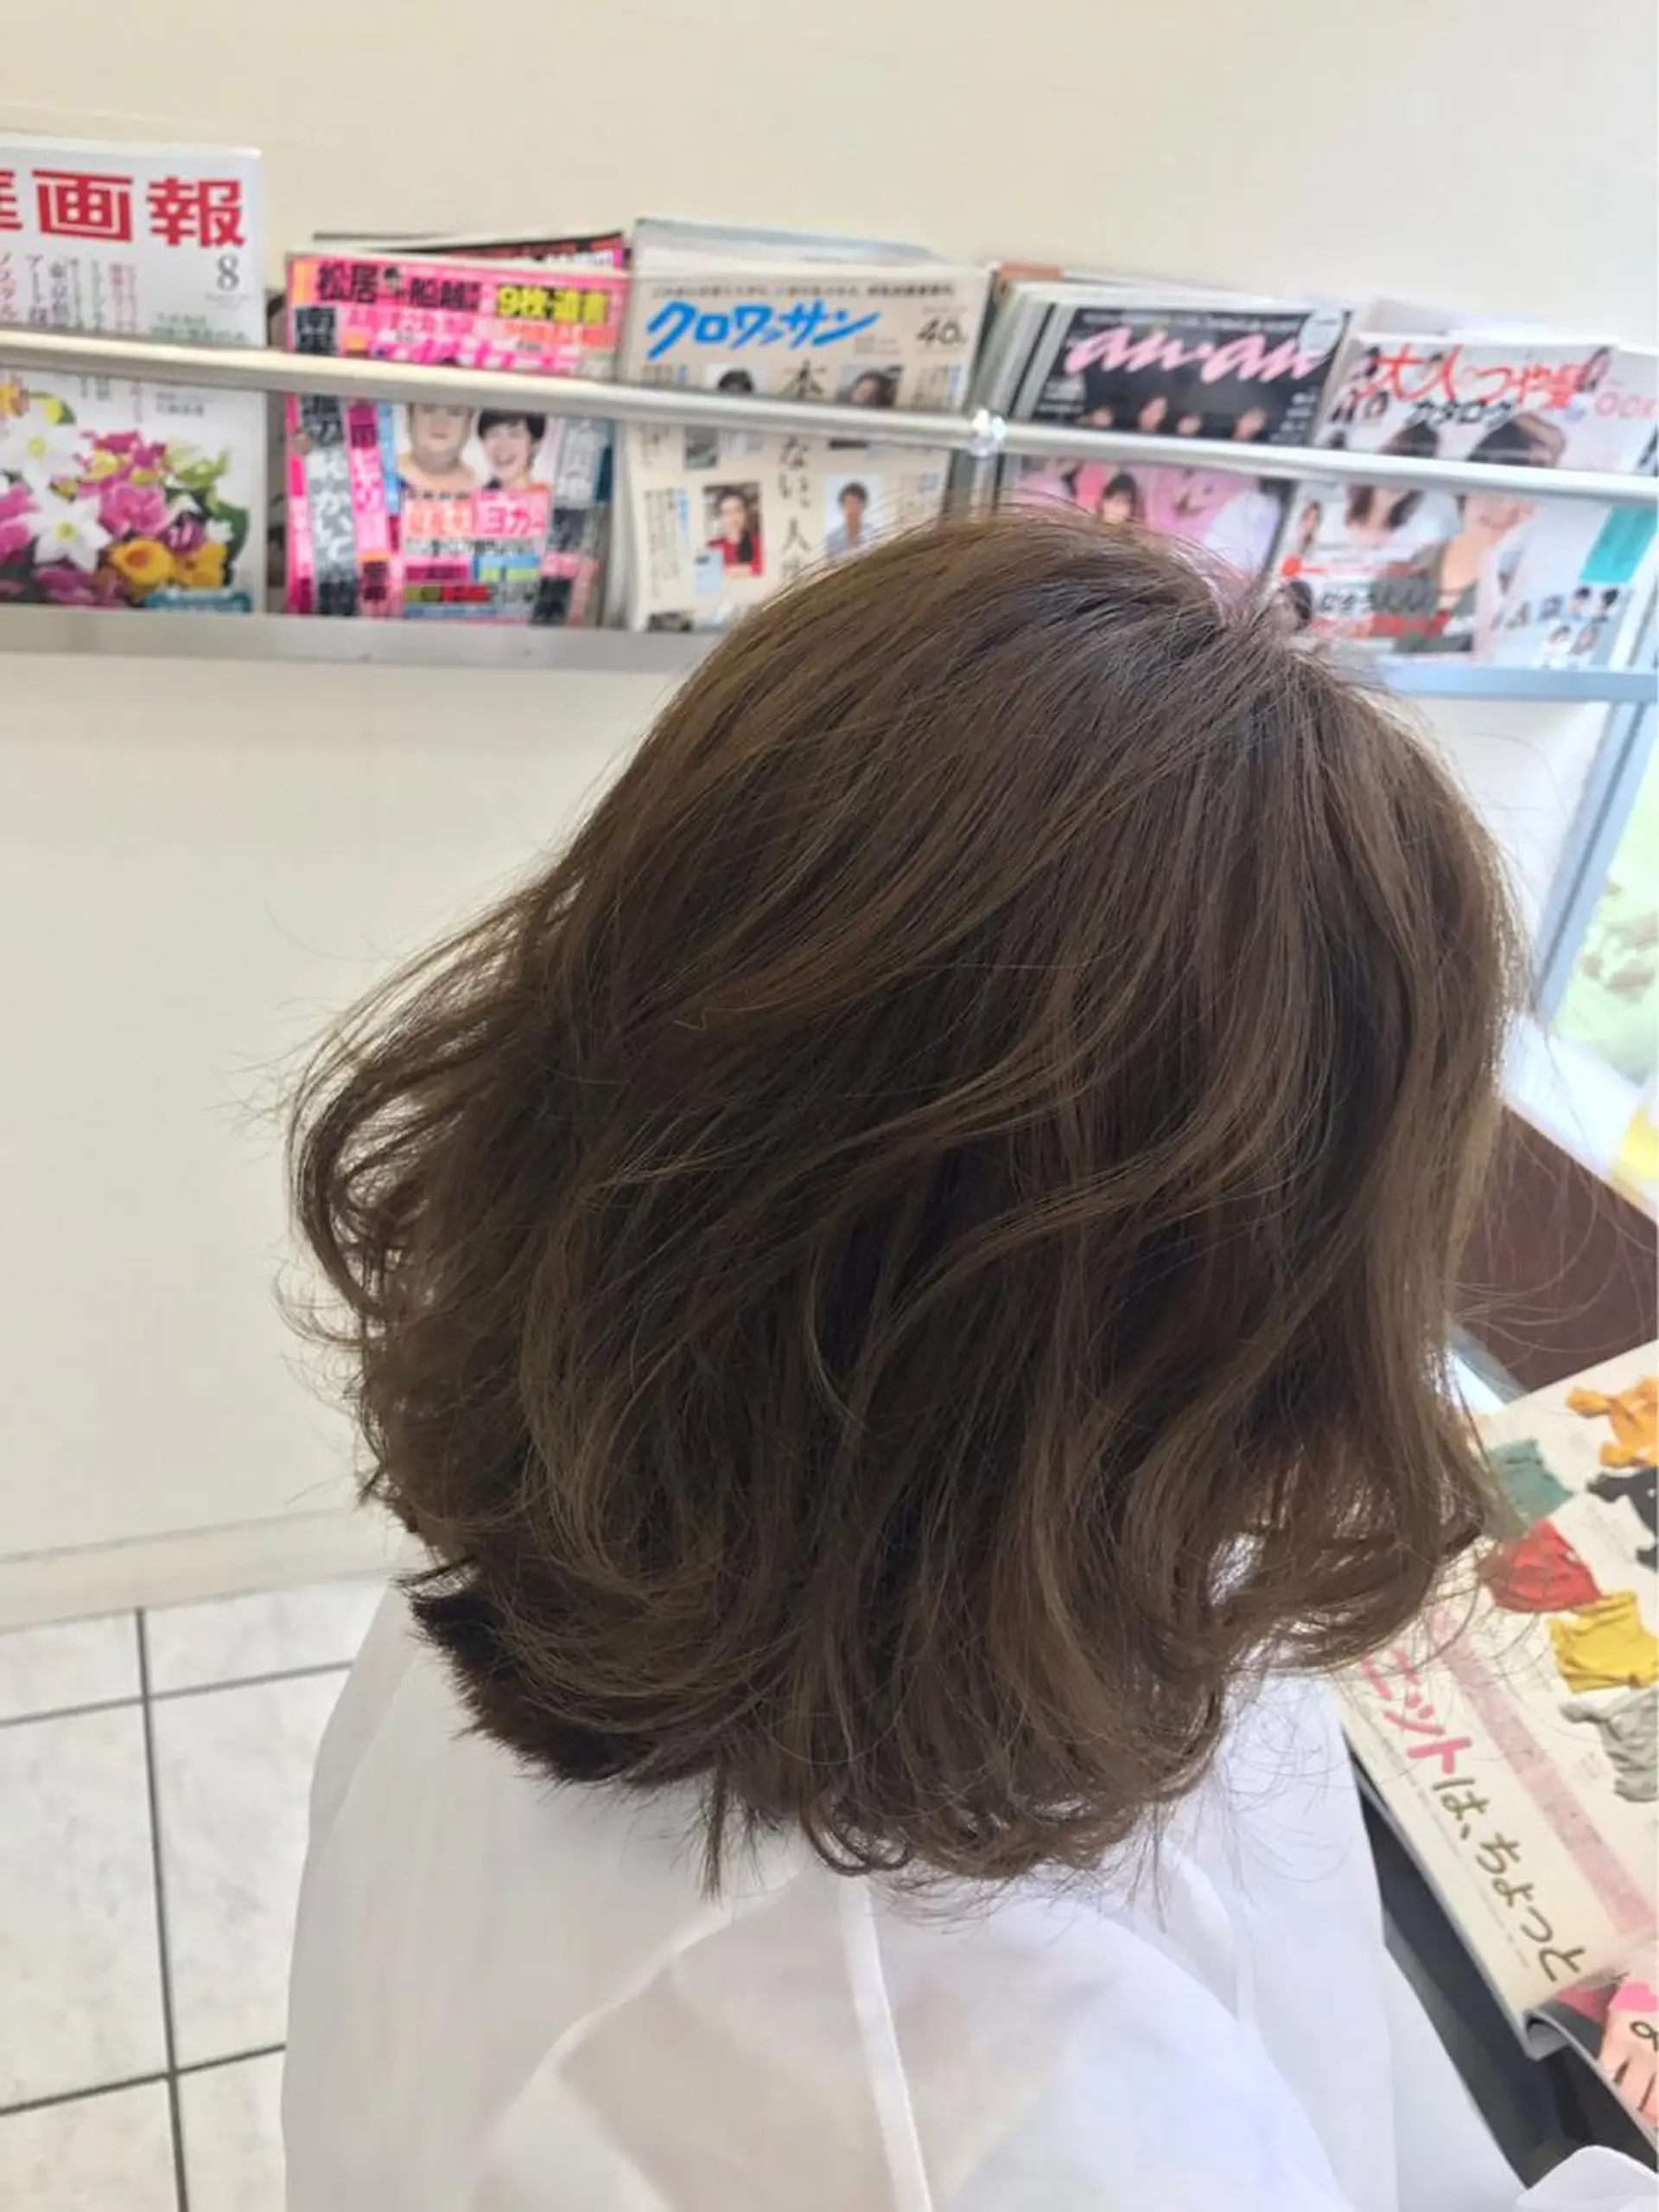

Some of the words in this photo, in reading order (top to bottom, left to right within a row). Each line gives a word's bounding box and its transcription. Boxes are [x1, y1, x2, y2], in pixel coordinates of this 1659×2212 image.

[216, 253, 240, 291] 8
[645, 298, 882, 361] クロワッサン
